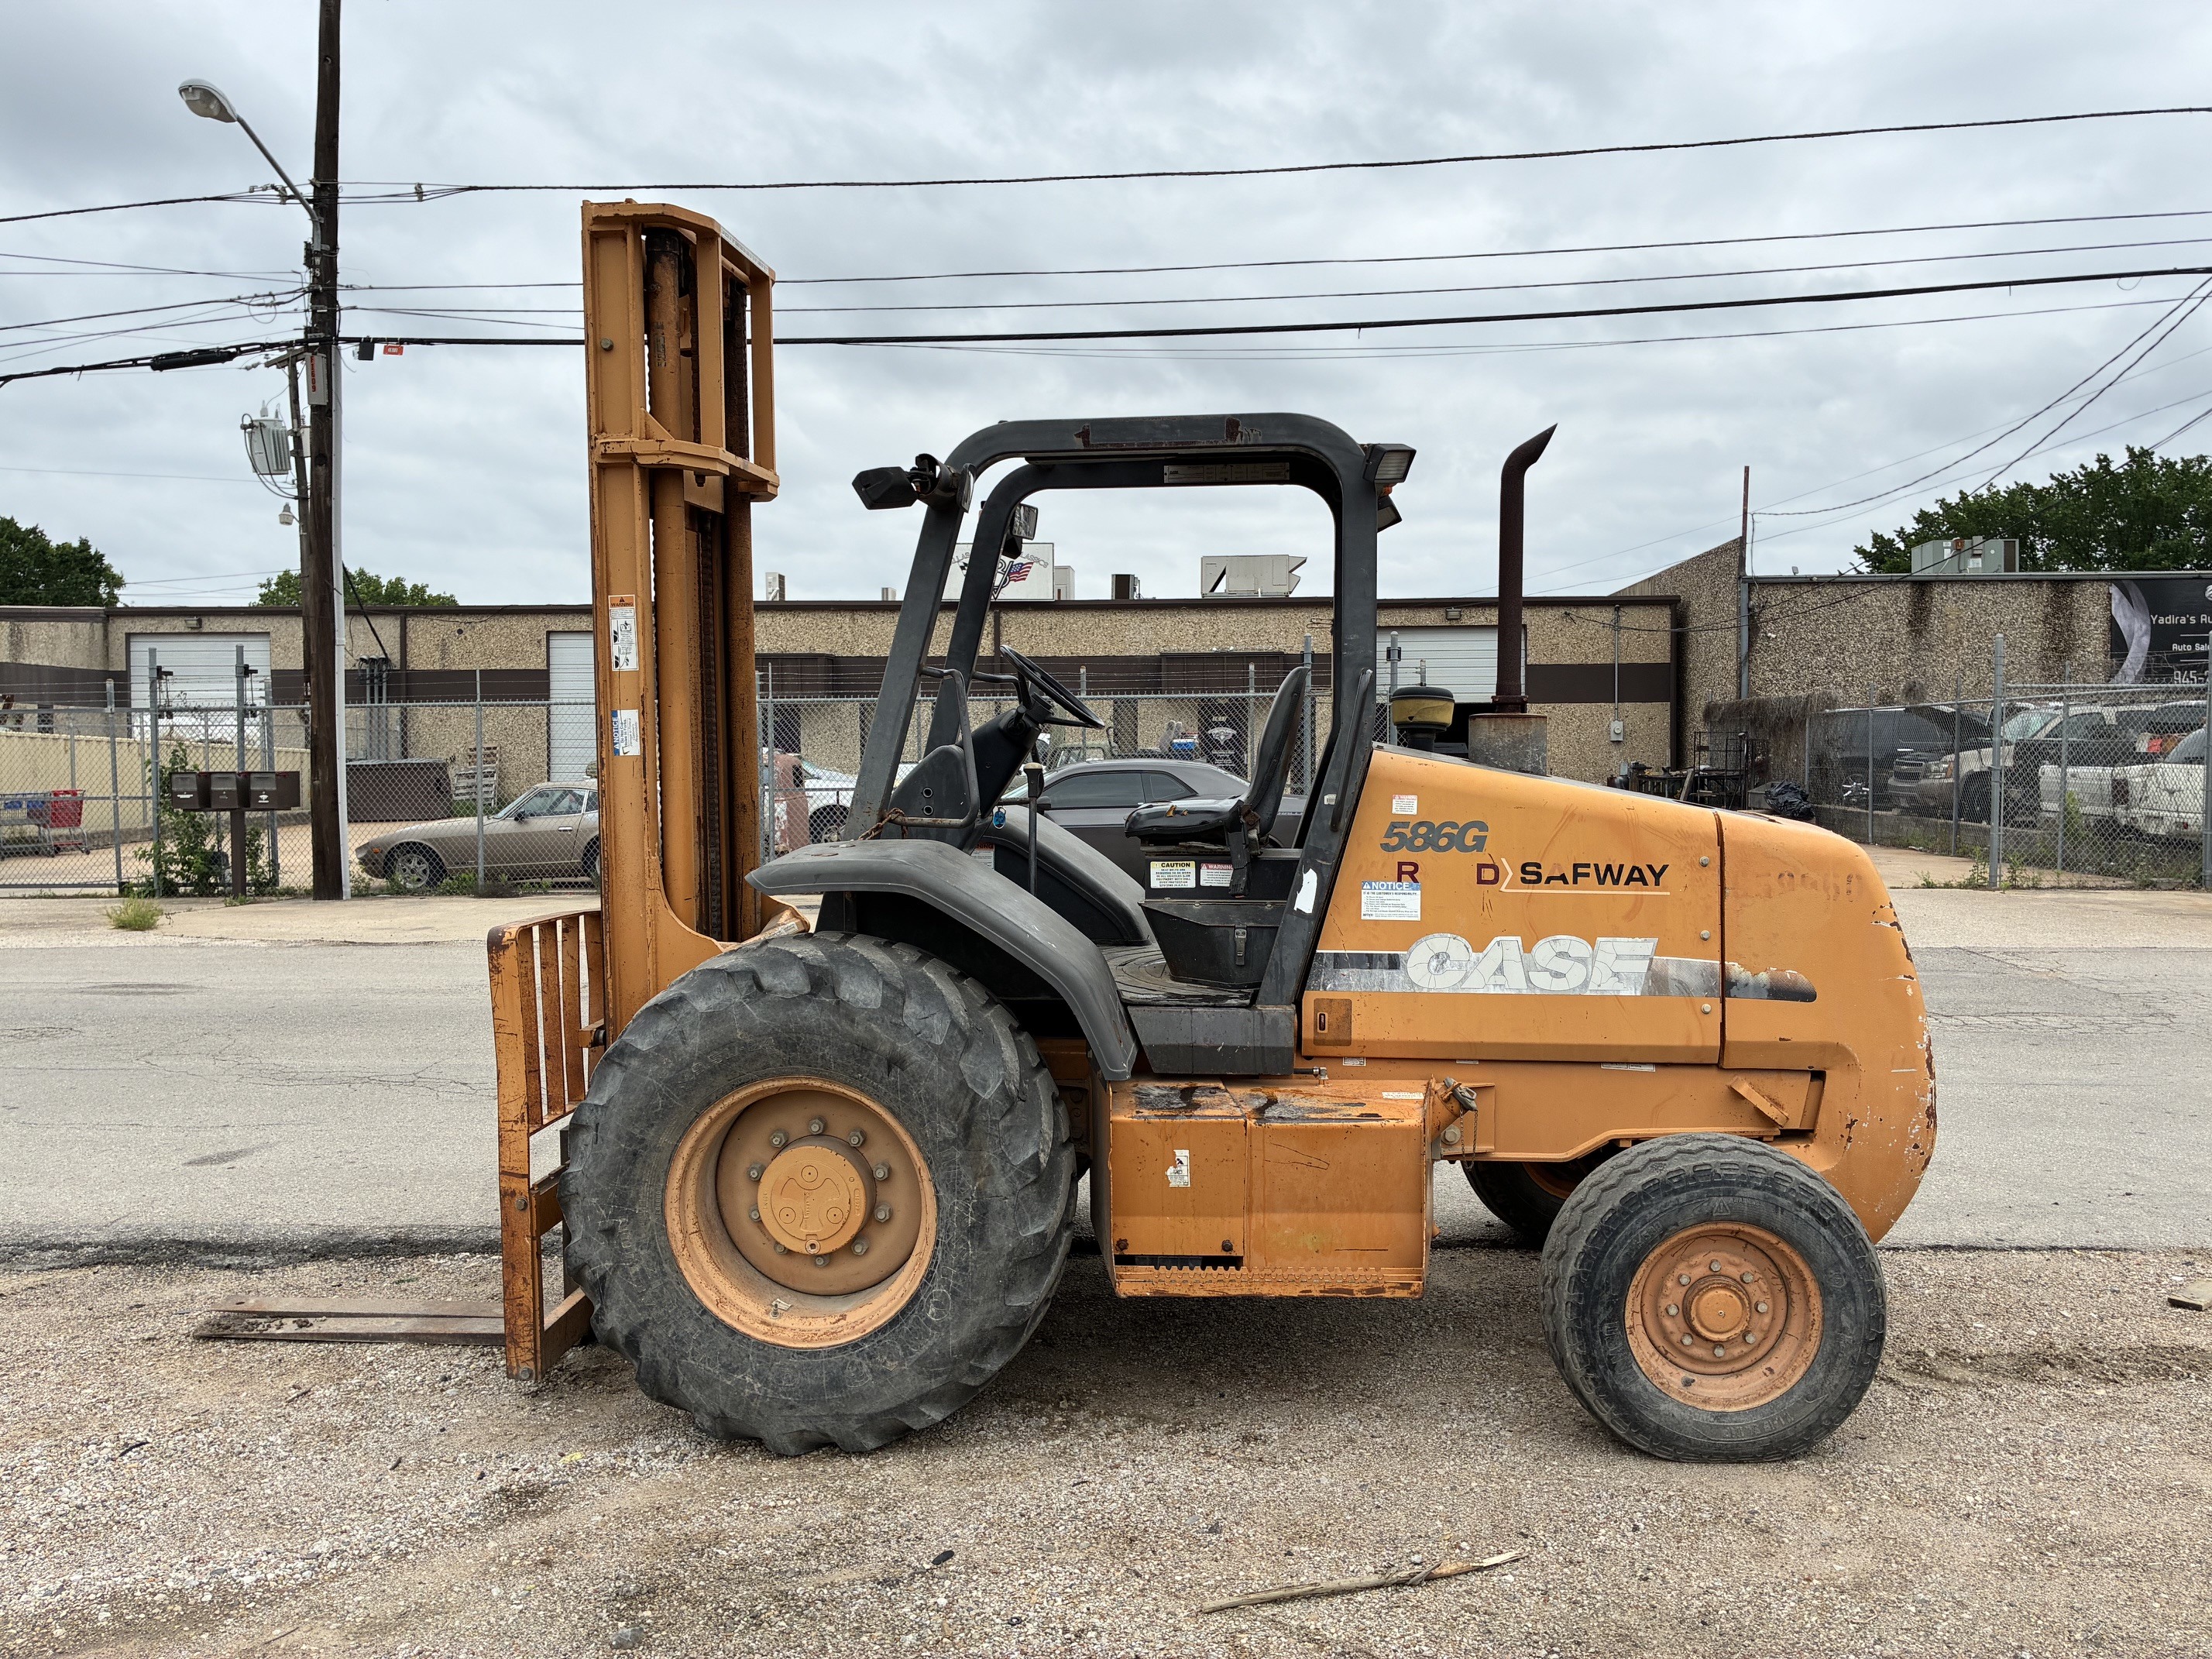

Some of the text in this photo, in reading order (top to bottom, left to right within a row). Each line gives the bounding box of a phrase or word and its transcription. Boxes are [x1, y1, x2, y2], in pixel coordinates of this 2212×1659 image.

[1020, 552, 1049, 568] LASSICS
[2150, 614, 2196, 624] Yadira's
[1380, 821, 1489, 853] 586G
[1520, 861, 1670, 886] SAFWAY
[1372, 881, 1410, 890] NOTICE
[1407, 933, 1657, 994] CASE
